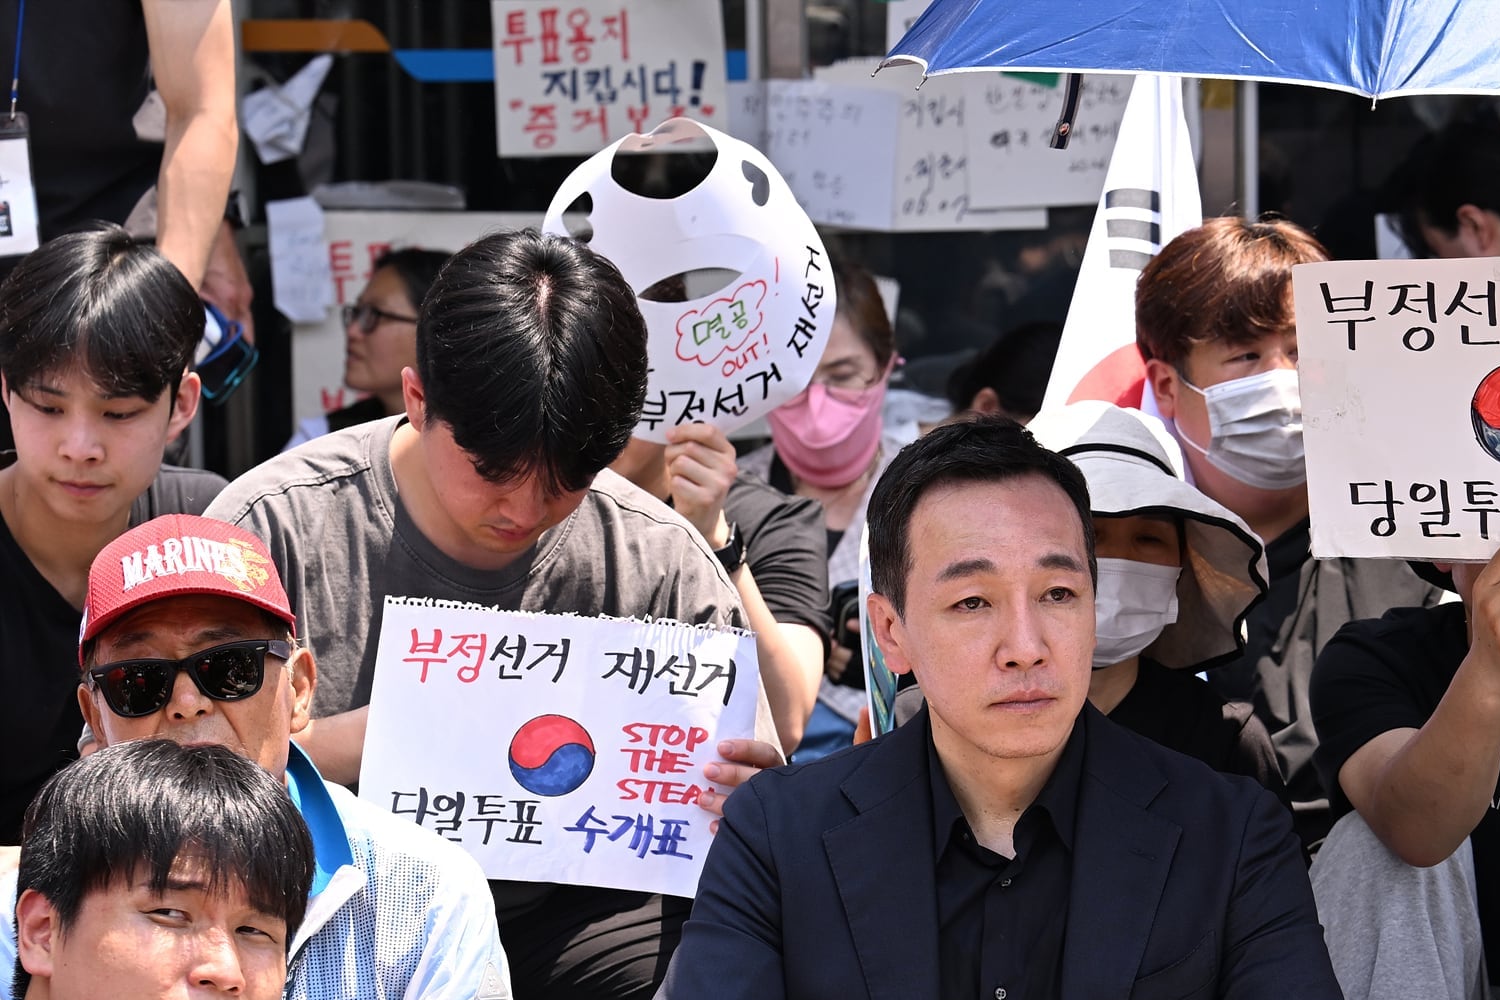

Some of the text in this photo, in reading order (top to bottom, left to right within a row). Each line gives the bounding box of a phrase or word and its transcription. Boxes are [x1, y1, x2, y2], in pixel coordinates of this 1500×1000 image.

[501, 8, 629, 65] 투표용지
[542, 60, 706, 106] 지킵시다!
[692, 299, 748, 346] 멸공
[787, 245, 825, 359] 재선거
[721, 332, 769, 378] OUT!
[641, 362, 782, 431] 부정선거
[120, 536, 256, 593] MARINES
[402, 628, 738, 706] 부정선거 재선거
[620, 748, 695, 775] THE
[622, 722, 709, 753] STOP
[616, 778, 715, 806] STEA
[563, 805, 693, 860] 수개표
